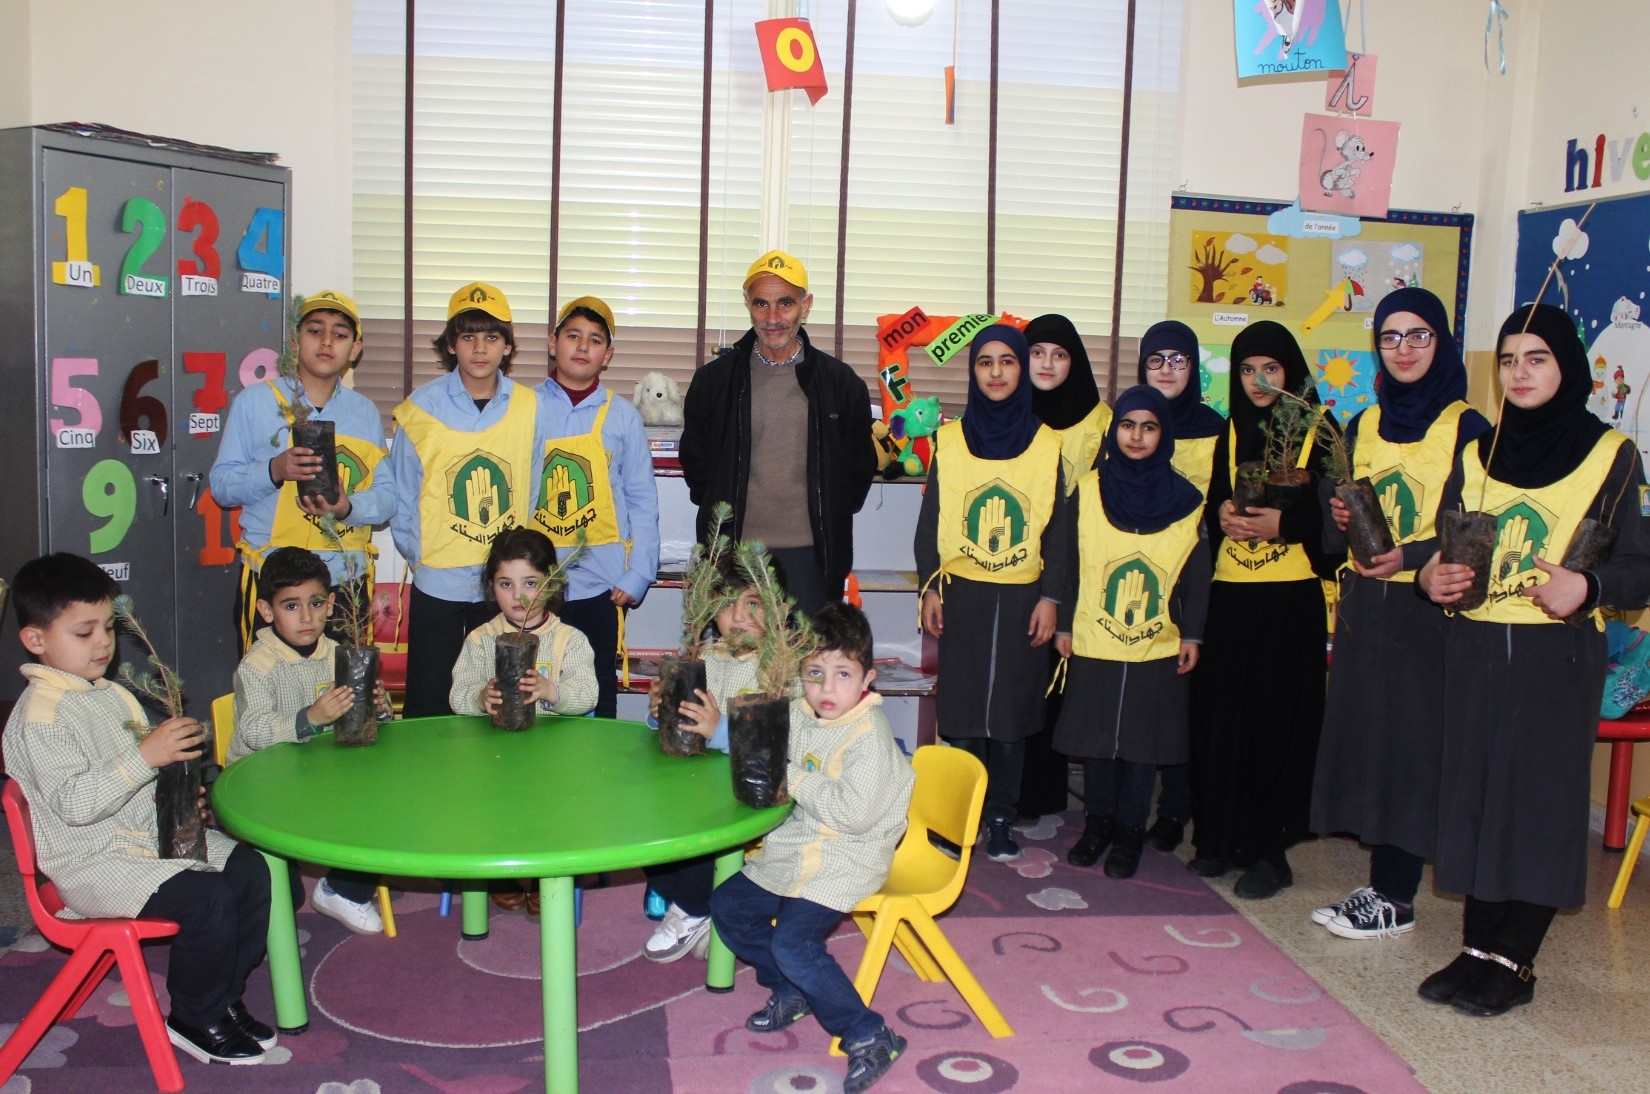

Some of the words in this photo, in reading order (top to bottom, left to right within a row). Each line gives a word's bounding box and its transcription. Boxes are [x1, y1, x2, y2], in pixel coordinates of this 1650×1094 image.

[1258, 50, 1324, 73] mouton
[53, 187, 100, 286] 1
[119, 197, 169, 297] 2
[177, 196, 221, 283] 3
[237, 208, 284, 299] 4
[69, 263, 93, 283] Un
[127, 275, 163, 293] Deux
[186, 276, 216, 293] Trois
[242, 275, 278, 291] Quatre
[883, 311, 928, 348] mon
[1214, 314, 1247, 323] L'Automne
[1614, 321, 1642, 331] Montagne
[50, 358, 102, 440] 5
[120, 360, 168, 450] 6
[184, 352, 228, 438] 7
[190, 415, 219, 430] Sept
[59, 429, 95, 448] Cinq
[132, 432, 156, 452] Six
[82, 459, 137, 554] 9
[103, 563, 130, 580] euf
[992, 548, 1028, 572] جهاد
[1129, 621, 1163, 646] جهاد
